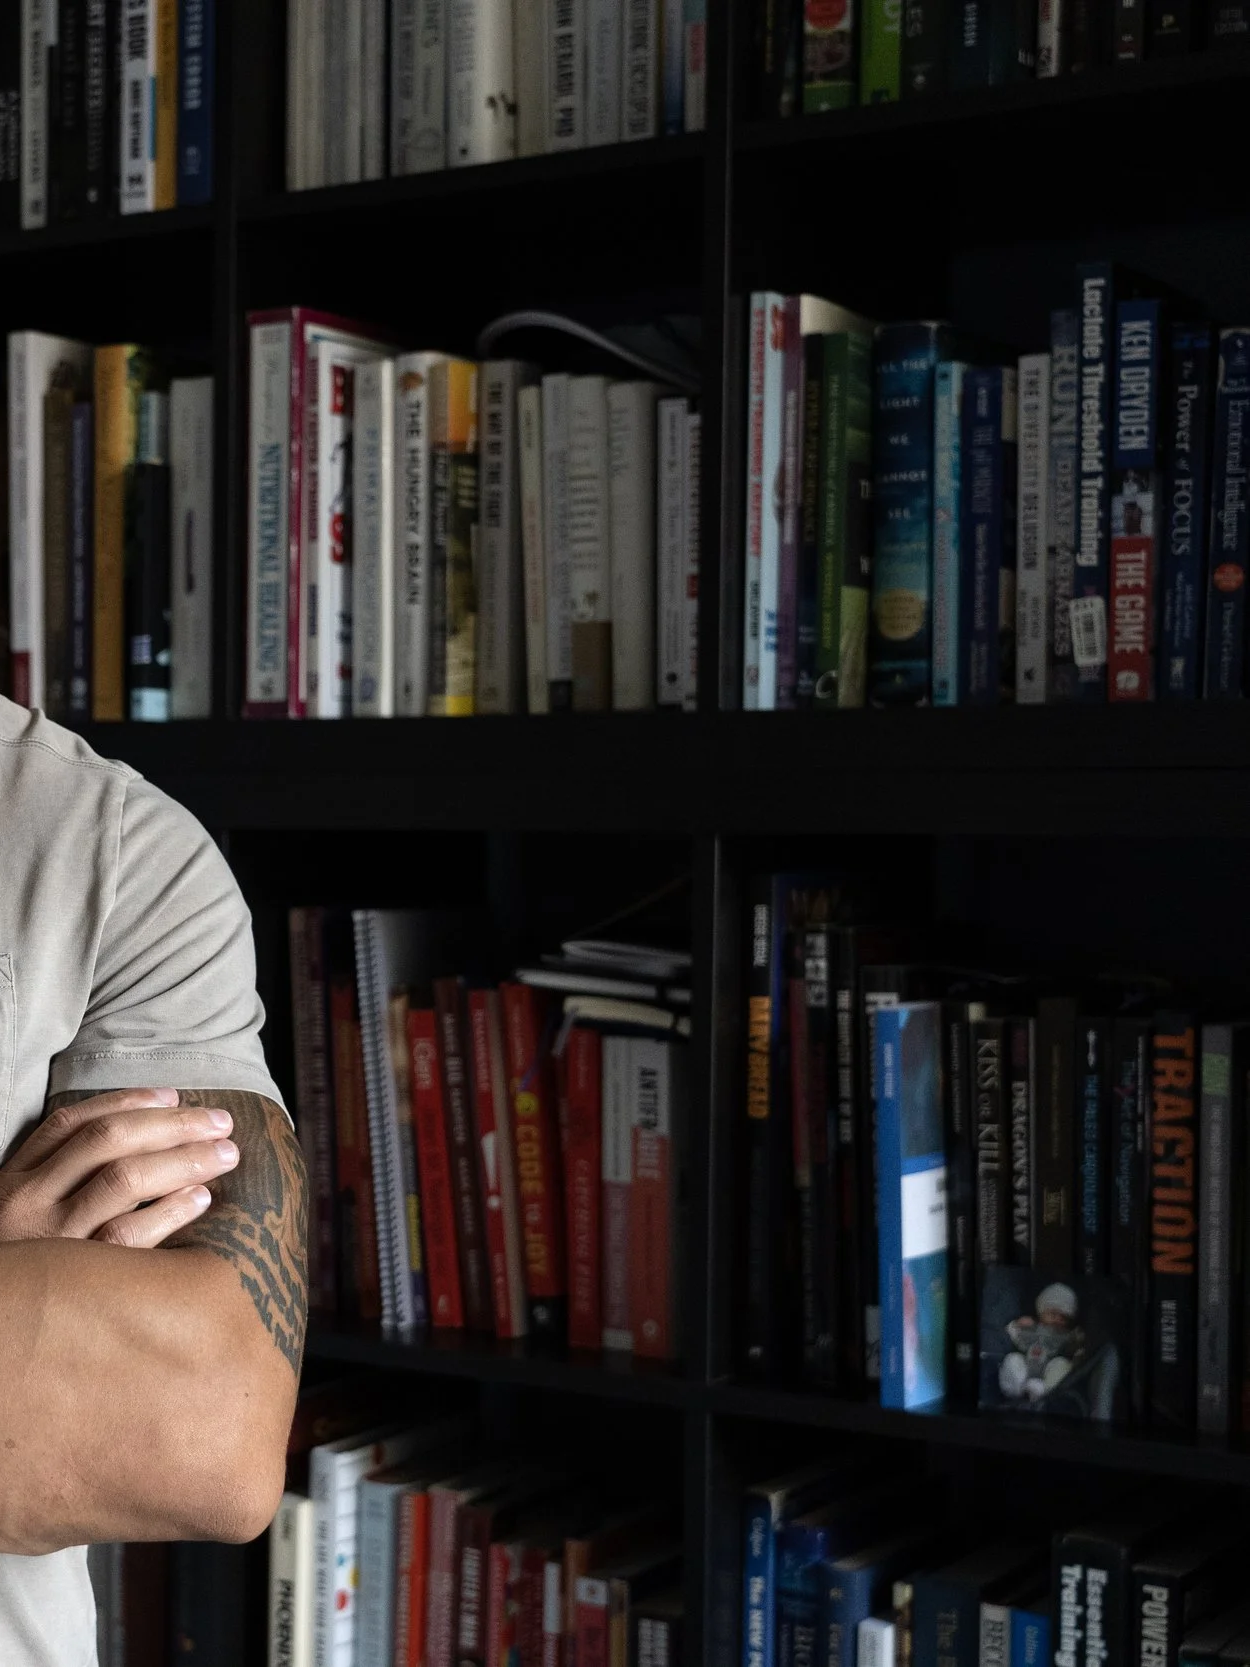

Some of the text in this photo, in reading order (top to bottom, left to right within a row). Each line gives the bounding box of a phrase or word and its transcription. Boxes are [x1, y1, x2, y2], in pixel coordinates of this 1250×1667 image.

[1076, 277, 1107, 566] Lactate Threshold Training
[1118, 319, 1151, 450] KEN DRYDEN
[1175, 384, 1201, 452] Power
[406, 399, 422, 605] THE HUNGRY BRAIN
[1170, 476, 1194, 556] FOCUS
[1217, 476, 1247, 552] Intelligence
[1114, 549, 1147, 654] THE GAME
[977, 1039, 1001, 1091] KISS
[517, 1124, 546, 1196] CODE
[977, 1122, 1002, 1174] KILL
[1150, 1027, 1196, 1273] TRACTION
[526, 1230, 549, 1278] JOY
[1012, 1192, 1029, 1249] PLAY
[1140, 1583, 1170, 1667] POWER
